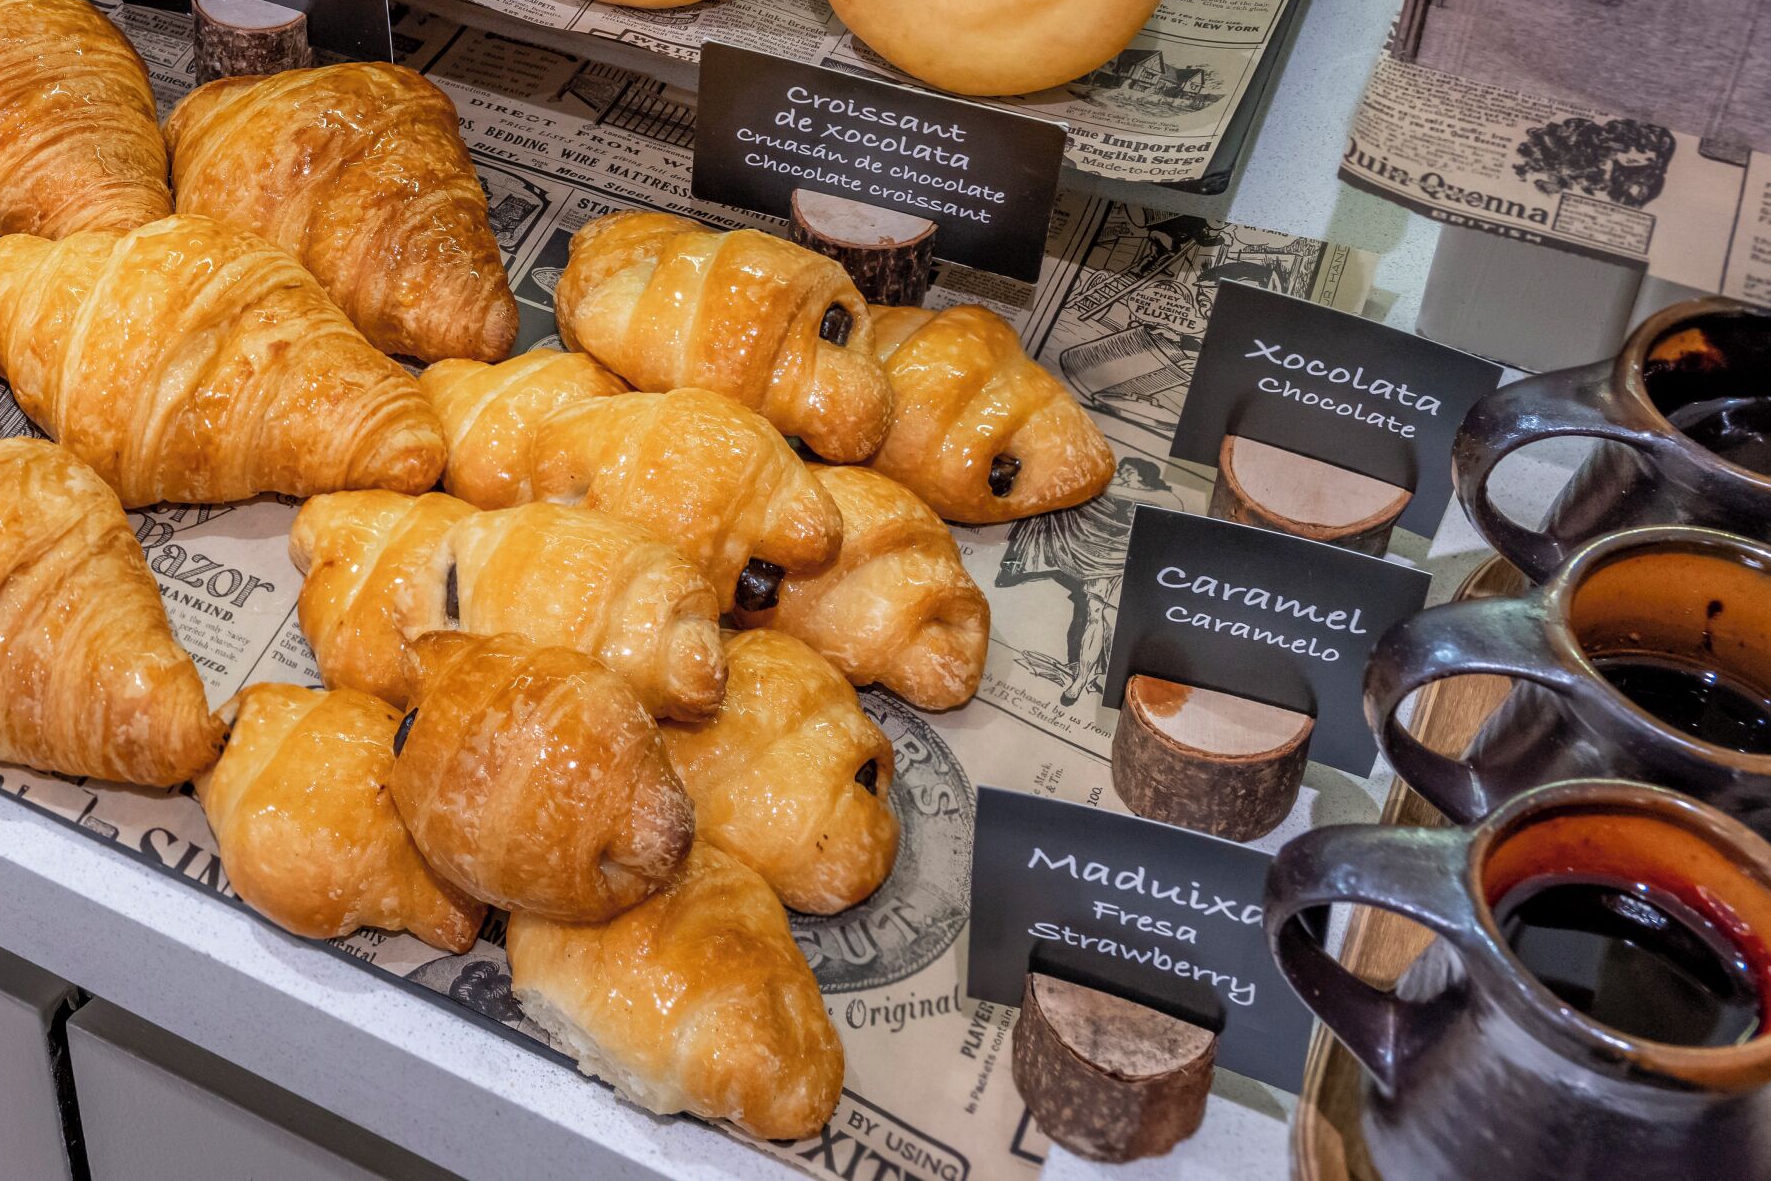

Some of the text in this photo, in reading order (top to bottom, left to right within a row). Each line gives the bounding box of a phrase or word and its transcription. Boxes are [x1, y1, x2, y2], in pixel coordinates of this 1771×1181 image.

[1193, 21, 1261, 34] NEW YORK
[469, 97, 641, 157] DIRECT FROM
[774, 108, 971, 170] de xocolata
[786, 86, 968, 142] Croissant
[473, 141, 521, 162] RILEY,
[483, 124, 550, 156] BEDDING,
[559, 147, 601, 170] WIRE
[736, 128, 1006, 204] Cruasán de chocolate
[1076, 142, 1206, 167] English Serge
[1080, 155, 1194, 176] Made-to-Order
[1099, 132, 1213, 154] Imported
[744, 153, 992, 224] Chocolate croissant
[1133, 302, 1198, 331] FLUXITE
[1135, 291, 1192, 313] MUST HAVE
[1152, 290, 1180, 304] THEY
[1157, 304, 1190, 318] USING
[1244, 338, 1442, 417] Xocolata
[1257, 377, 1416, 440] Chocolate
[134, 511, 276, 609] Razor
[157, 582, 236, 625] MANKIND.
[1156, 565, 1367, 636] Caramel
[227, 629, 252, 646] Safety
[1164, 605, 1340, 662] Caramelo
[271, 649, 299, 670] Thus
[997, 680, 1113, 739] purchased by us from
[1027, 847, 1265, 927] Maduixa
[1093, 900, 1198, 945] Fresa
[1027, 921, 1256, 1006] Strawberry
[845, 984, 963, 1034] Original
[847, 1109, 881, 1138] BY
[884, 1131, 960, 1181] USING
